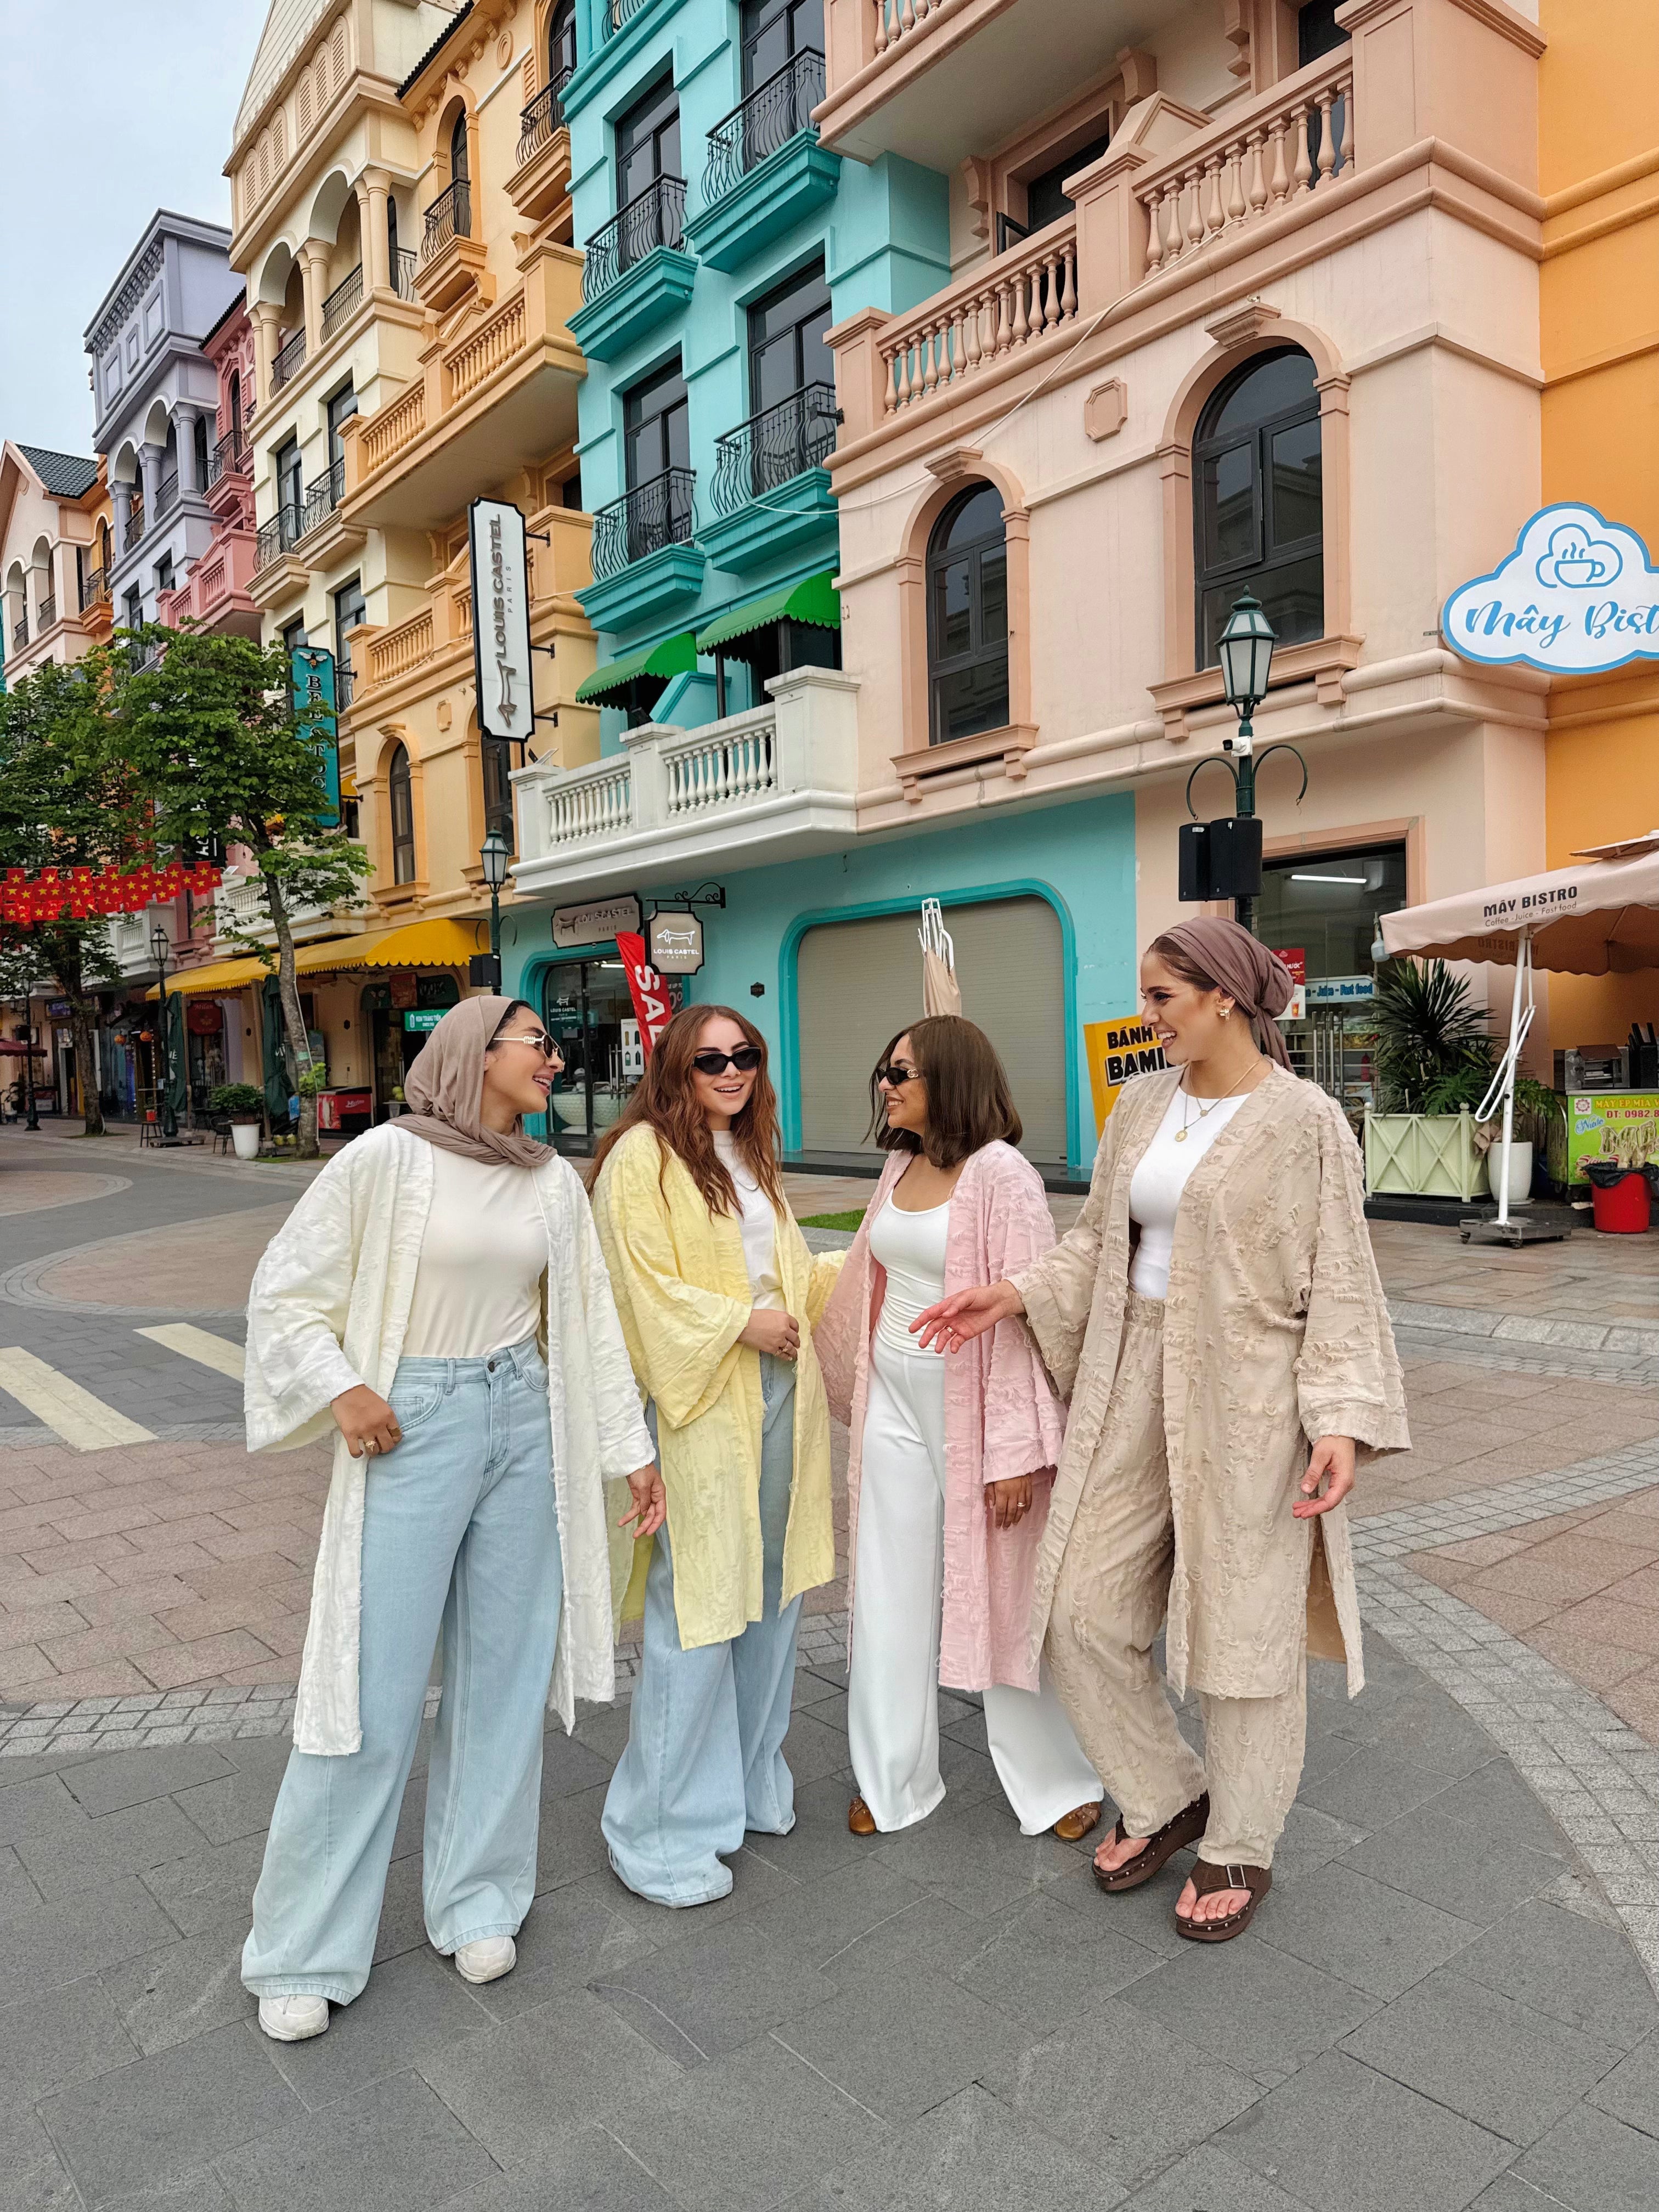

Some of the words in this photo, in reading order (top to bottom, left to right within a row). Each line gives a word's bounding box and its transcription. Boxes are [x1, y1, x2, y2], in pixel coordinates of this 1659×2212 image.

[489, 514, 504, 593] CASTEL
[505, 566, 514, 613] PARIS
[493, 596, 506, 658] LOUIS
[1465, 601, 1571, 649] Mây
[578, 912, 600, 924] LOUIS
[601, 907, 631, 920] CASTEL
[1483, 900, 1516, 917] MÂY
[1522, 886, 1577, 909] BISTRO
[1485, 916, 1509, 927] Coffee
[1541, 906, 1557, 915] Fast
[1559, 901, 1577, 911] food
[635, 964, 665, 1048] SAL
[1107, 1025, 1154, 1049] BÁNH
[1105, 1046, 1176, 1085] BAMI
